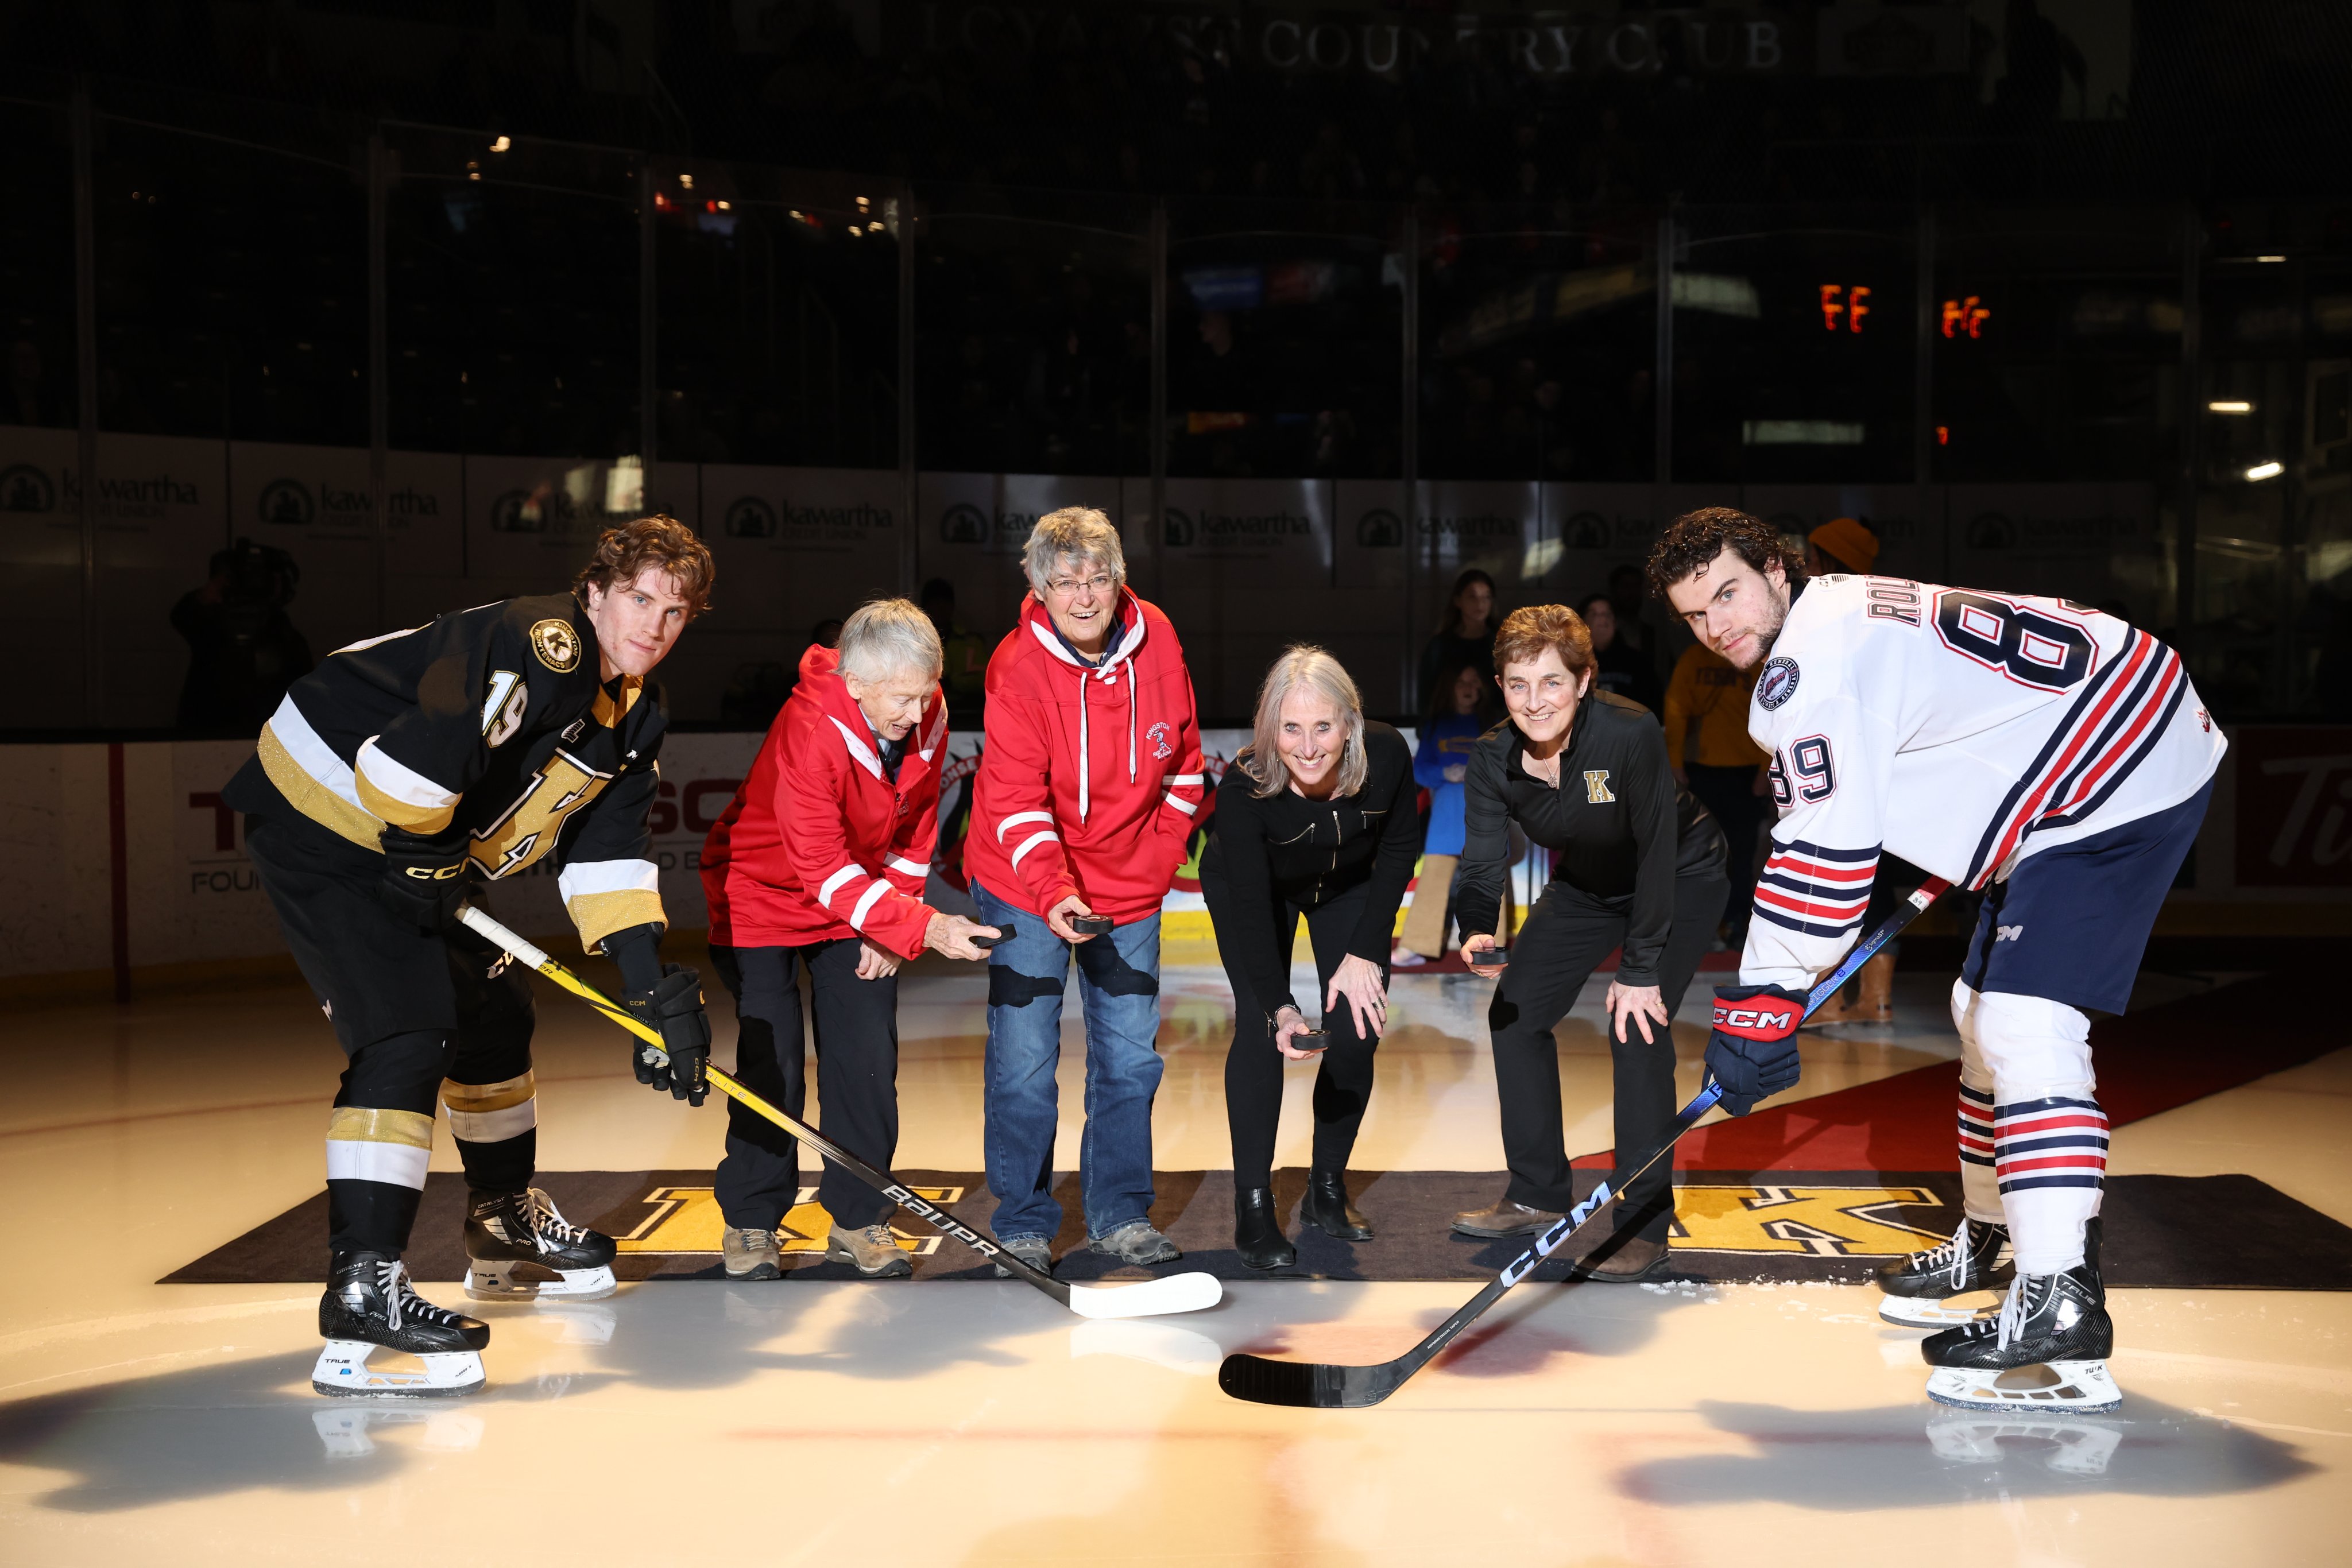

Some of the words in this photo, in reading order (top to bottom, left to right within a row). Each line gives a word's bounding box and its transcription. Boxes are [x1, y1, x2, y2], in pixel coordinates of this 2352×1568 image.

[1608, 21, 1780, 72] CUB
[62, 467, 199, 505] kwartha
[321, 482, 439, 516] kawrtha
[782, 498, 893, 528] kawartha
[1200, 509, 1312, 535] kawartha
[1865, 575, 1921, 628] ROL
[555, 622, 579, 657] KINGSTON
[1931, 587, 2103, 696] 8
[482, 669, 529, 749] 19
[1146, 722, 1170, 741] KINGSTON
[1583, 769, 1616, 804] K
[1767, 734, 1838, 808] 89
[2261, 753, 2352, 868] Ti
[1912, 897, 1922, 907] 89
[1808, 976, 1839, 1009] RIGGER
[1712, 1007, 1792, 1029] CCM
[478, 1197, 505, 1209] CATALYST
[1499, 1180, 1612, 1288] CCM
[2061, 1281, 2096, 1306] TRUE
[369, 1310, 388, 1321] PRO
[1426, 1328, 1451, 1350] ASYMMETRICAL
[1449, 1320, 1460, 1330] TAPER
